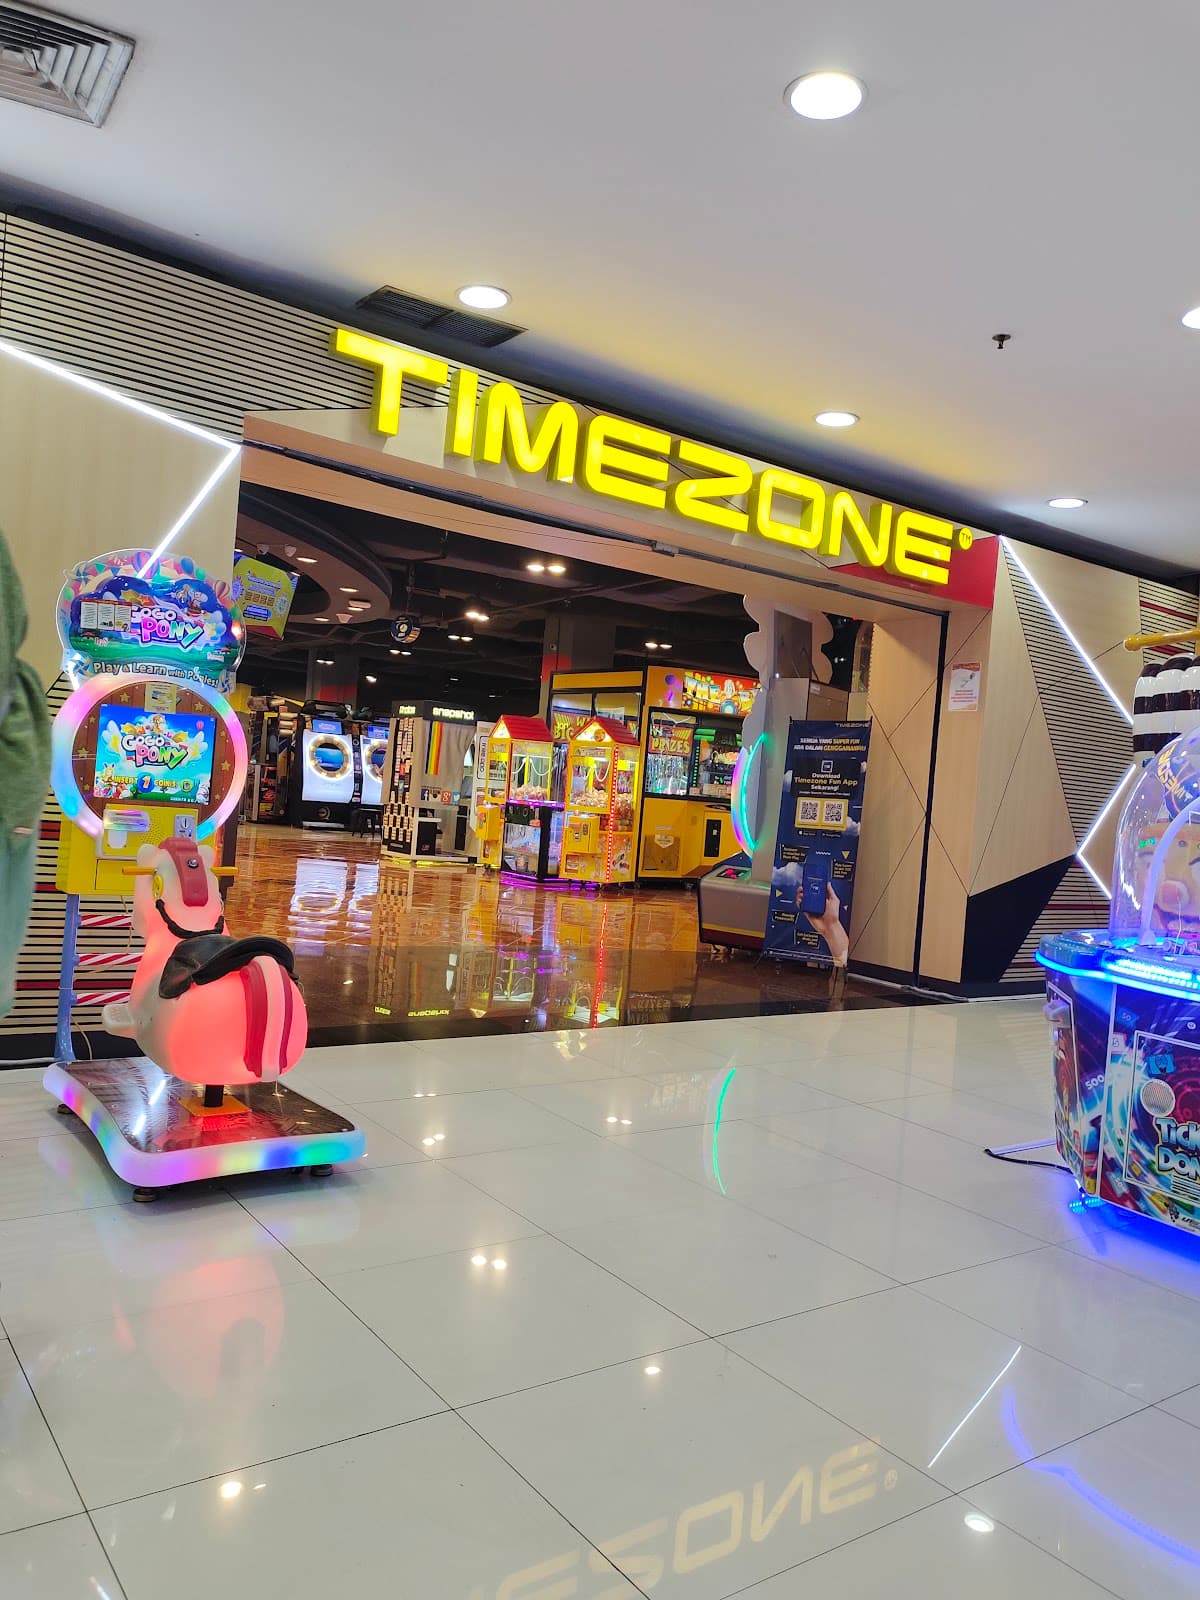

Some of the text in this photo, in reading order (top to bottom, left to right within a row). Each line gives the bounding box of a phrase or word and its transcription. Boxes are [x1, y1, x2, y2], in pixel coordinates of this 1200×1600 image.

[329, 327, 954, 585] TIMEZONE
[141, 615, 203, 648] PONY
[93, 662, 121, 675] Play
[132, 663, 166, 675] Learn
[168, 669, 185, 678] with
[432, 707, 474, 720] snapshot
[651, 738, 690, 754] PRIZES
[135, 744, 188, 769] PONY
[794, 777, 827, 785] Timezone
[843, 779, 858, 787] App
[1085, 1074, 1105, 1090] 500
